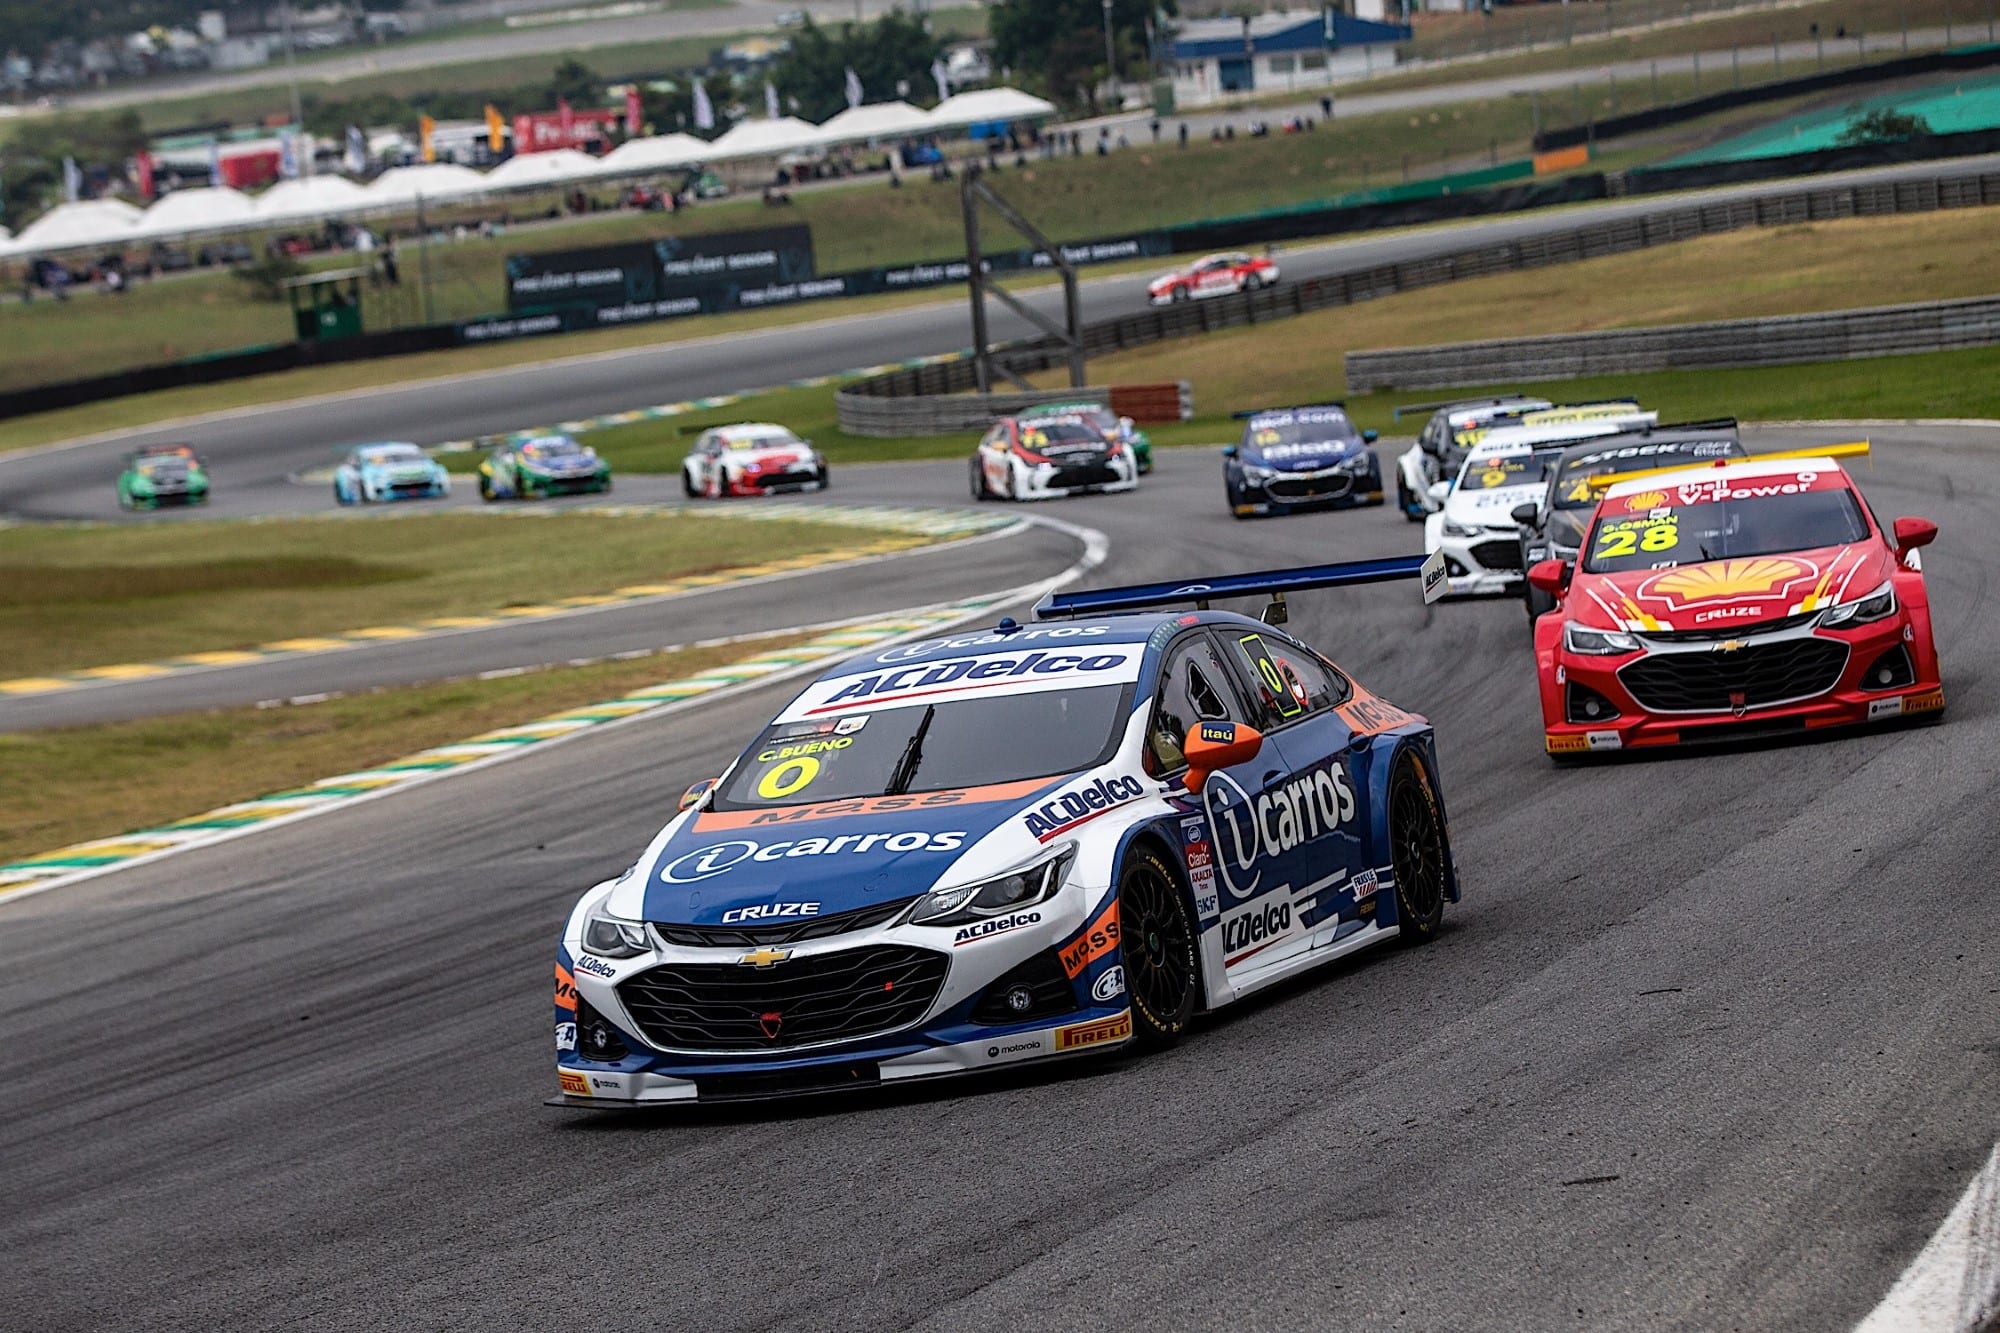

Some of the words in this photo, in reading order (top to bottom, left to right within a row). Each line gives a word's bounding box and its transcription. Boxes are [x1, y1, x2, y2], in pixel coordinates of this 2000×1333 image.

[1677, 479, 1728, 496] Shell
[1678, 483, 1812, 505] V-Power
[1596, 524, 1679, 559] 28
[1695, 605, 1762, 623] CRUZE
[826, 652, 1127, 704] ACDelco
[1259, 657, 1283, 694] 0
[1202, 726, 1233, 742] Itaú
[758, 737, 853, 761] C.BUENO
[757, 756, 820, 799] 0
[1023, 775, 1144, 838] ACDelco
[1188, 850, 1206, 868] Claro
[1191, 868, 1213, 883] AXALTA
[722, 902, 821, 924] CRUZE
[1197, 895, 1217, 914] SKF
[954, 912, 1042, 942] ACDelco
[577, 955, 616, 978] ACDelco
[1098, 966, 1124, 998] CBA
[1063, 1014, 1129, 1047] PIRELLI
[1001, 1041, 1041, 1054] motorola
